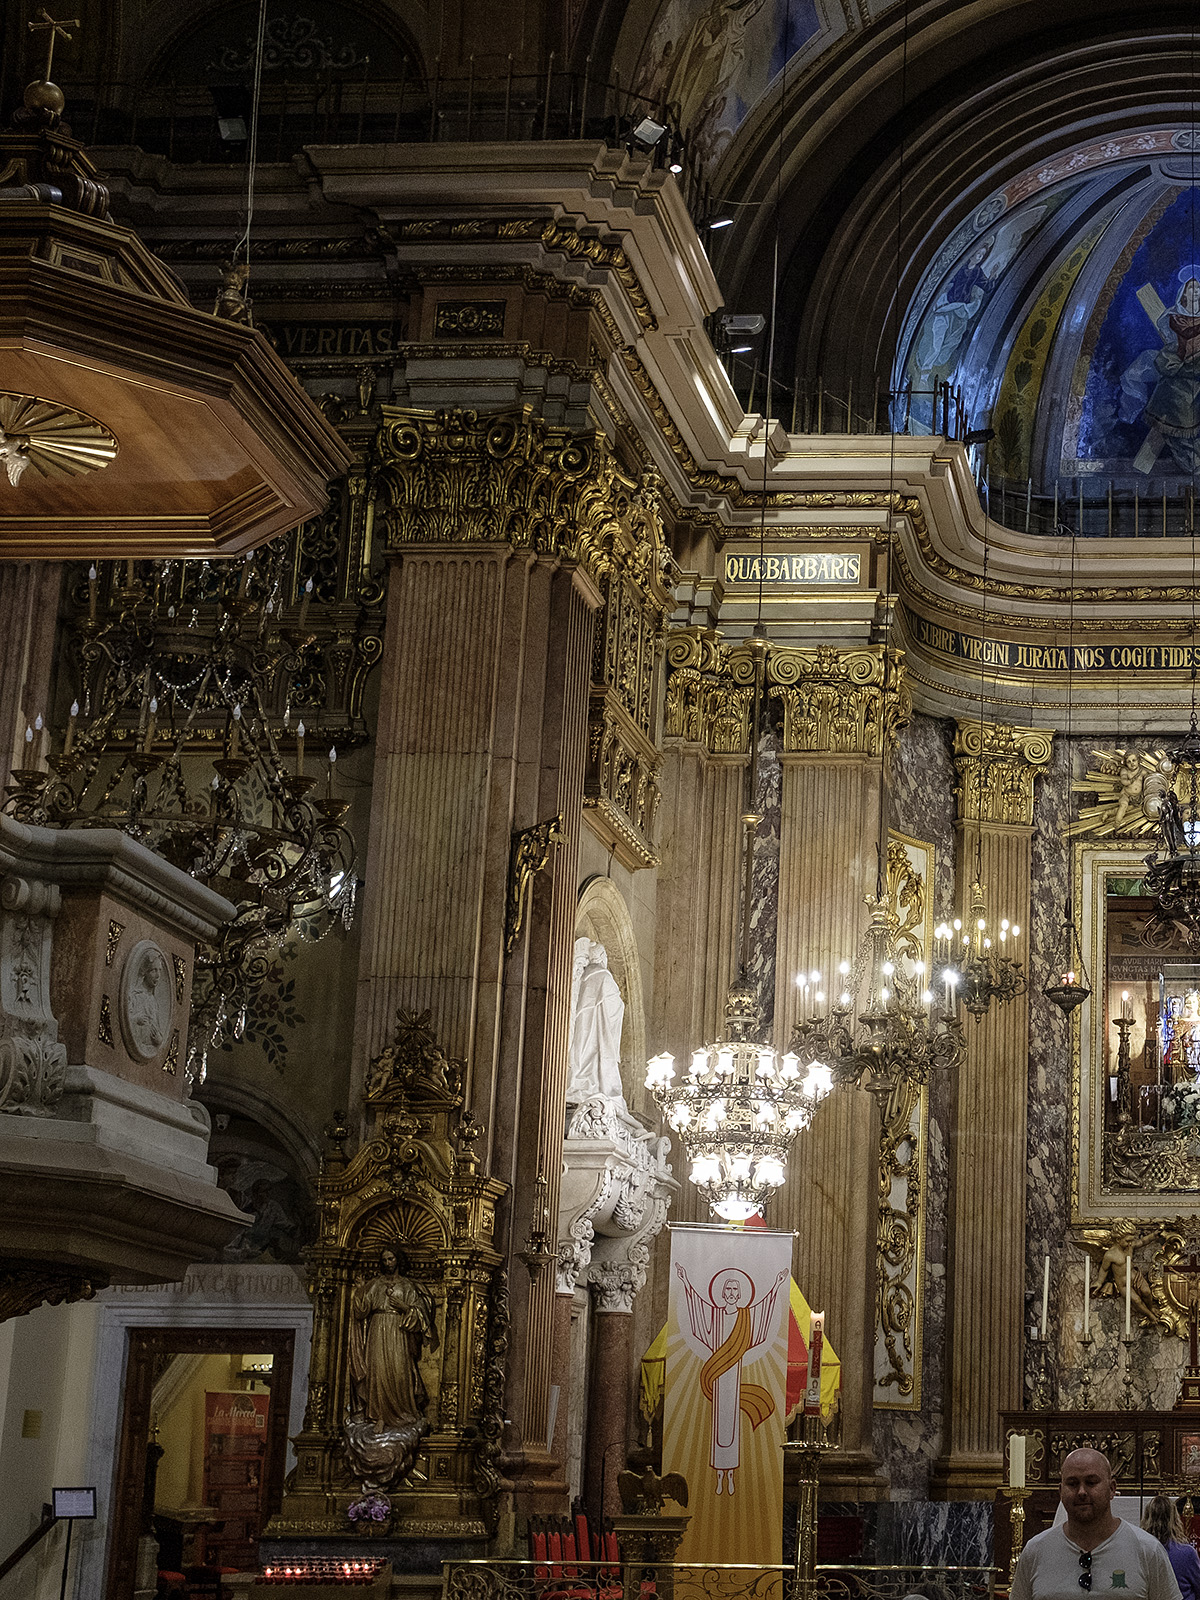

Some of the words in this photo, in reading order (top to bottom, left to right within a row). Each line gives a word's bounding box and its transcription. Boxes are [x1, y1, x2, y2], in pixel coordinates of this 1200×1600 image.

[283, 326, 394, 354] VERITAS
[920, 620, 956, 653] SUBIRE
[961, 636, 1010, 666] VIRGINI
[1074, 647, 1105, 669] NOS
[1110, 647, 1158, 668] COGIT
[1144, 957, 1167, 965] MARIA
[1112, 972, 1134, 980] SOLA
[213, 1274, 303, 1294] CAPTIVORU
[213, 1405, 225, 1417] La
[225, 1406, 257, 1418] Merced
